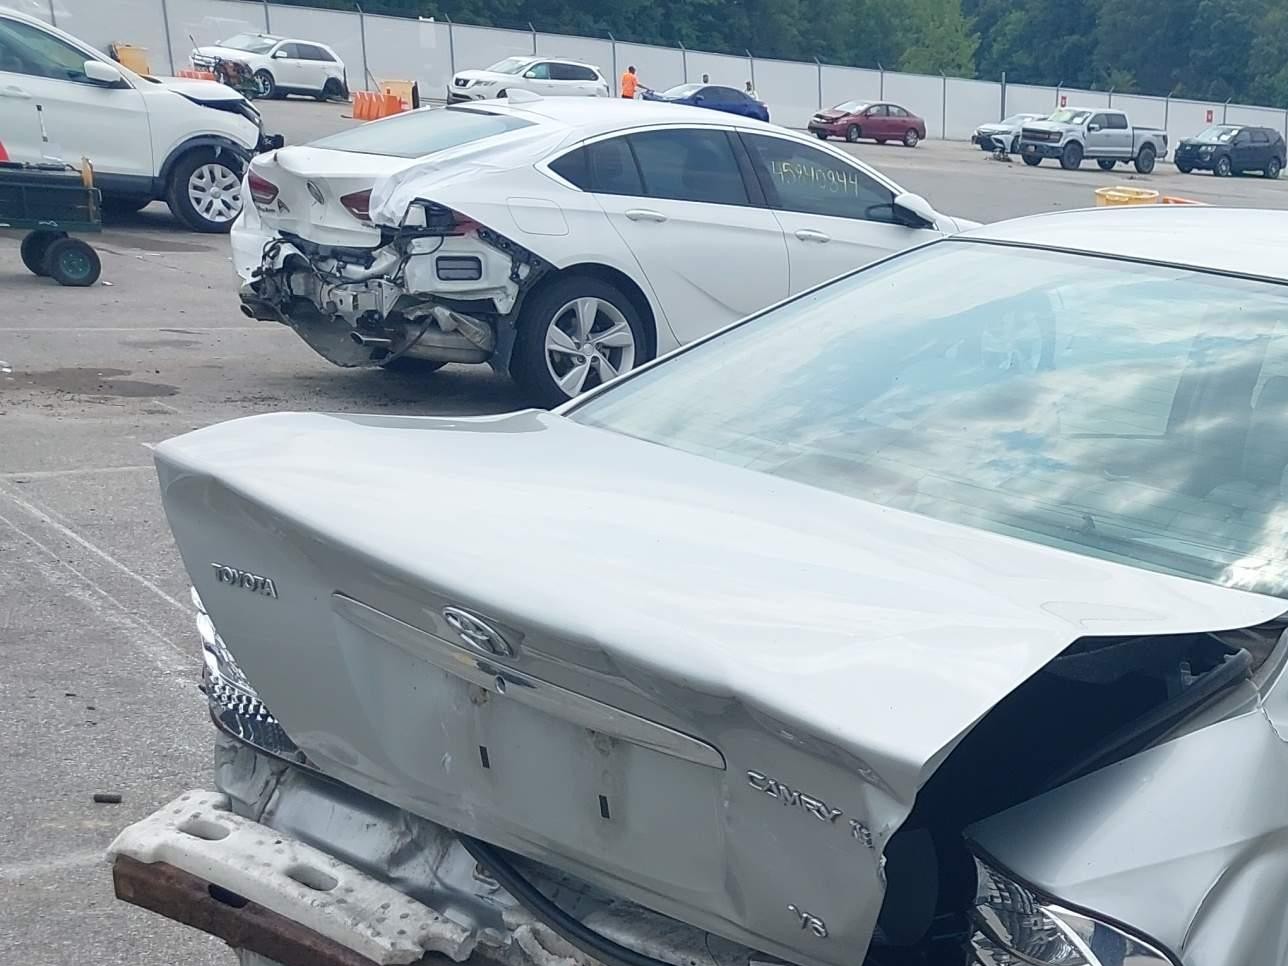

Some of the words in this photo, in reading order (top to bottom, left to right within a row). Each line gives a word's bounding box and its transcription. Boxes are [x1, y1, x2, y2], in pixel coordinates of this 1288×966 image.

[211, 562, 279, 600] TOYOTA
[746, 769, 843, 823] CAMRY
[787, 903, 829, 938] V6
